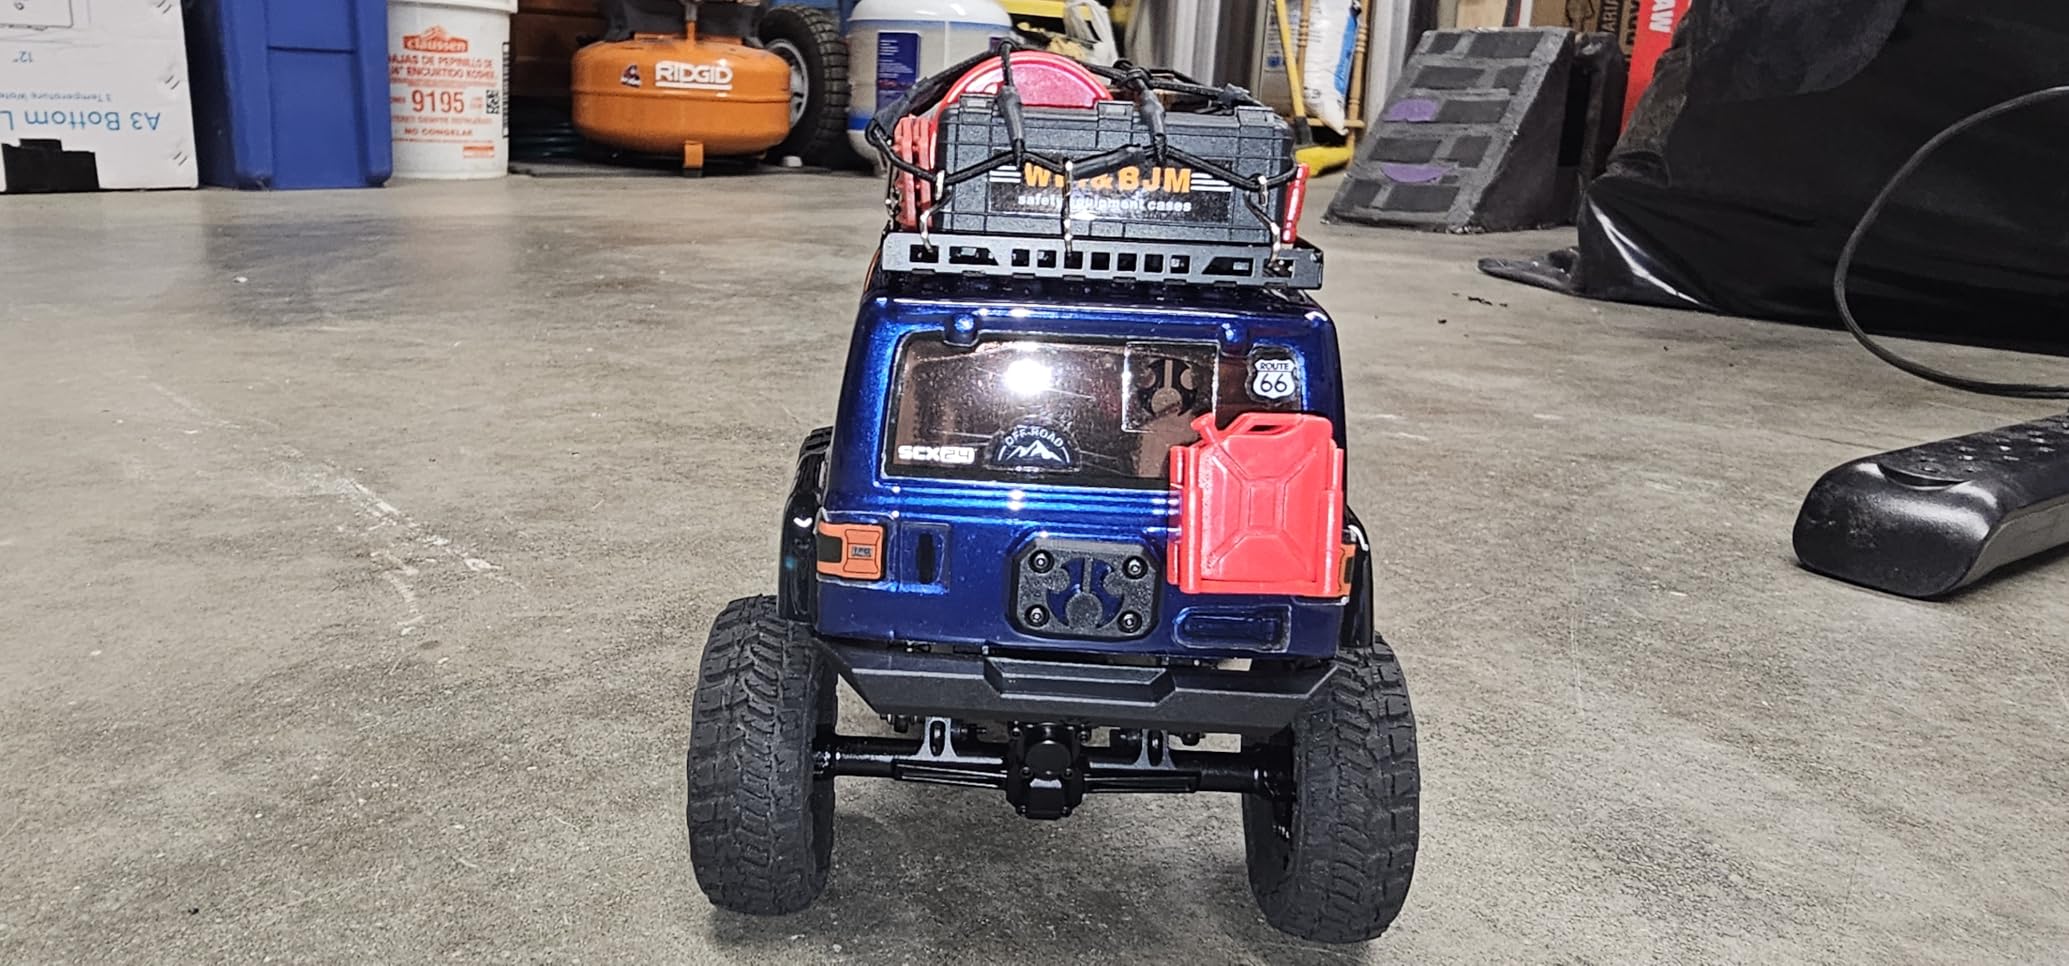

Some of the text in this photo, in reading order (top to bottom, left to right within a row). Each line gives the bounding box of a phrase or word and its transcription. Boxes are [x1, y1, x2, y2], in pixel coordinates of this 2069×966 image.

[655, 61, 733, 84] RIDGID
[412, 89, 465, 114] 9195
[24, 110, 121, 131] Bottom
[130, 111, 161, 131] A3
[1018, 193, 1063, 208] safety
[1147, 200, 1192, 212] cases
[1260, 362, 1289, 370] ROUTE
[1261, 373, 1287, 393] 66
[1004, 424, 1064, 447] OFF-ROAD
[898, 445, 975, 465] SCX24
